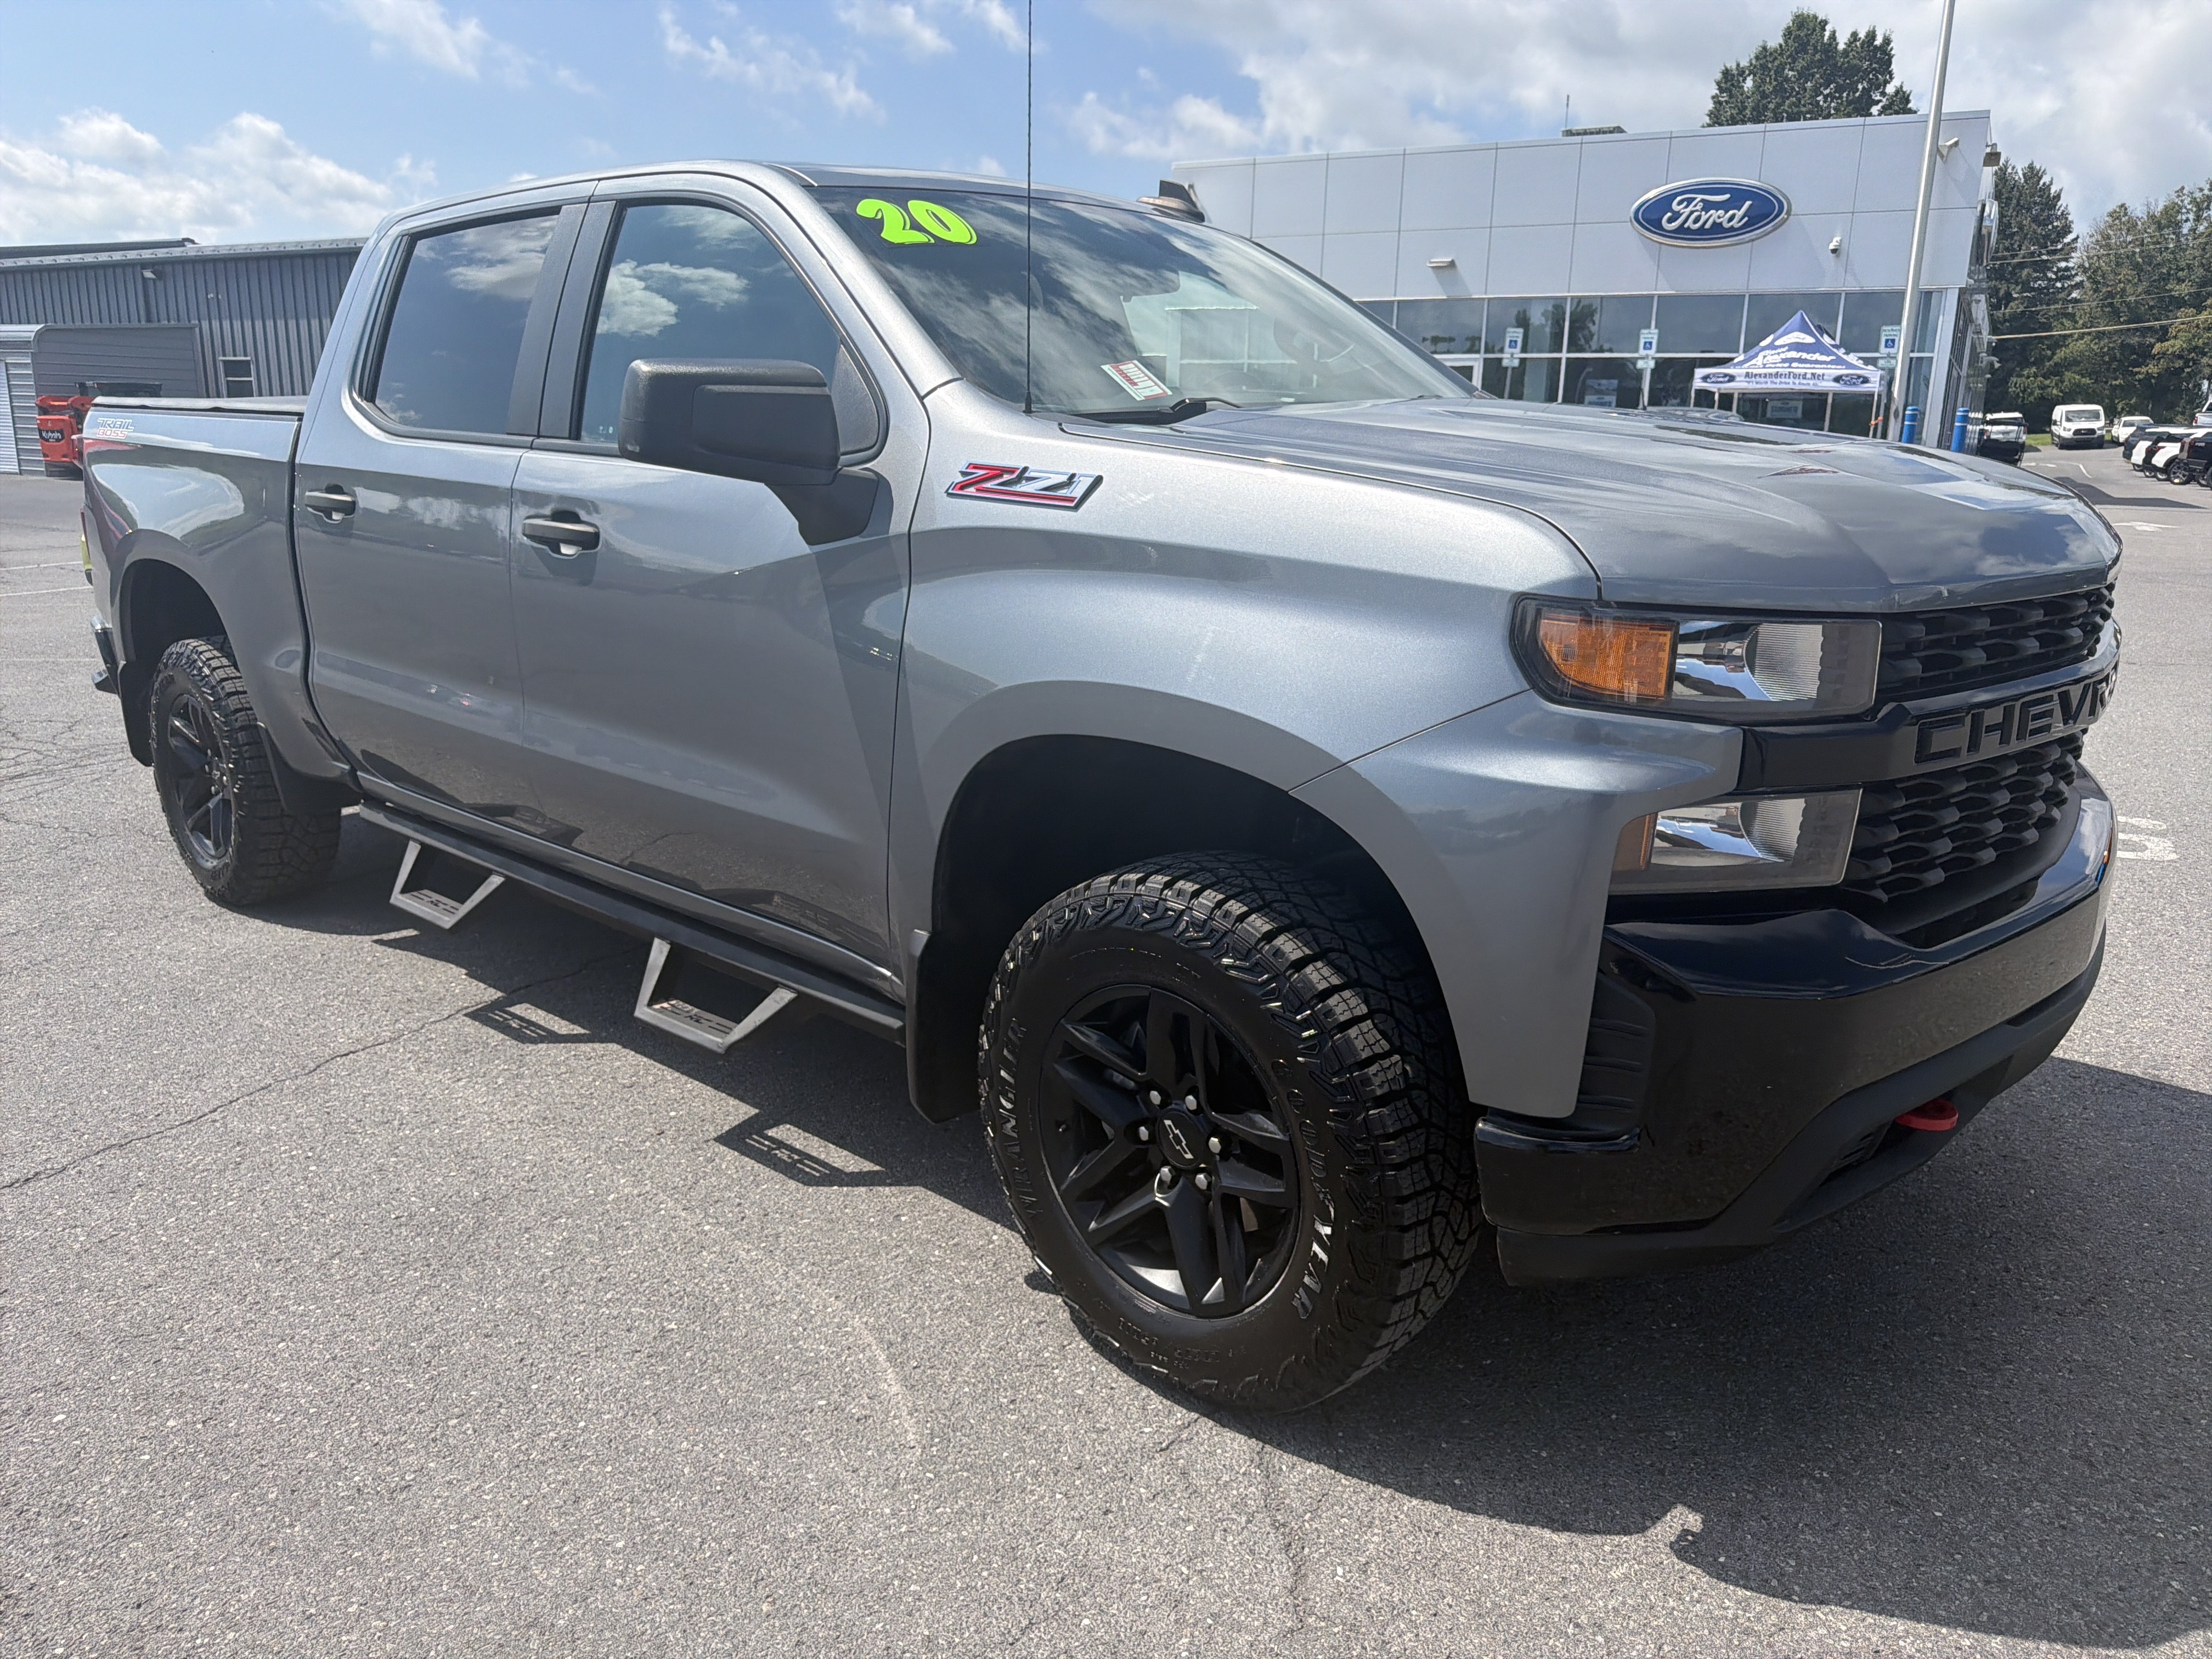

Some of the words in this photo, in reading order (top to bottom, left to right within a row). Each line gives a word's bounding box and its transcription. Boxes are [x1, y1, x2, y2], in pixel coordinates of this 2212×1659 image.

[856, 199, 977, 245] 20
[1662, 194, 1753, 230] Ford
[1706, 374, 1730, 382] Ford
[1744, 370, 1825, 381] AlexanderFord.Net
[1839, 375, 1864, 385] Ford
[97, 418, 134, 431] TRAIL
[97, 428, 128, 439] BOSS
[945, 461, 1104, 512] Z71
[997, 1018, 1043, 1218] WRANGLER
[1271, 1058, 1335, 1319] GOODYEAR
